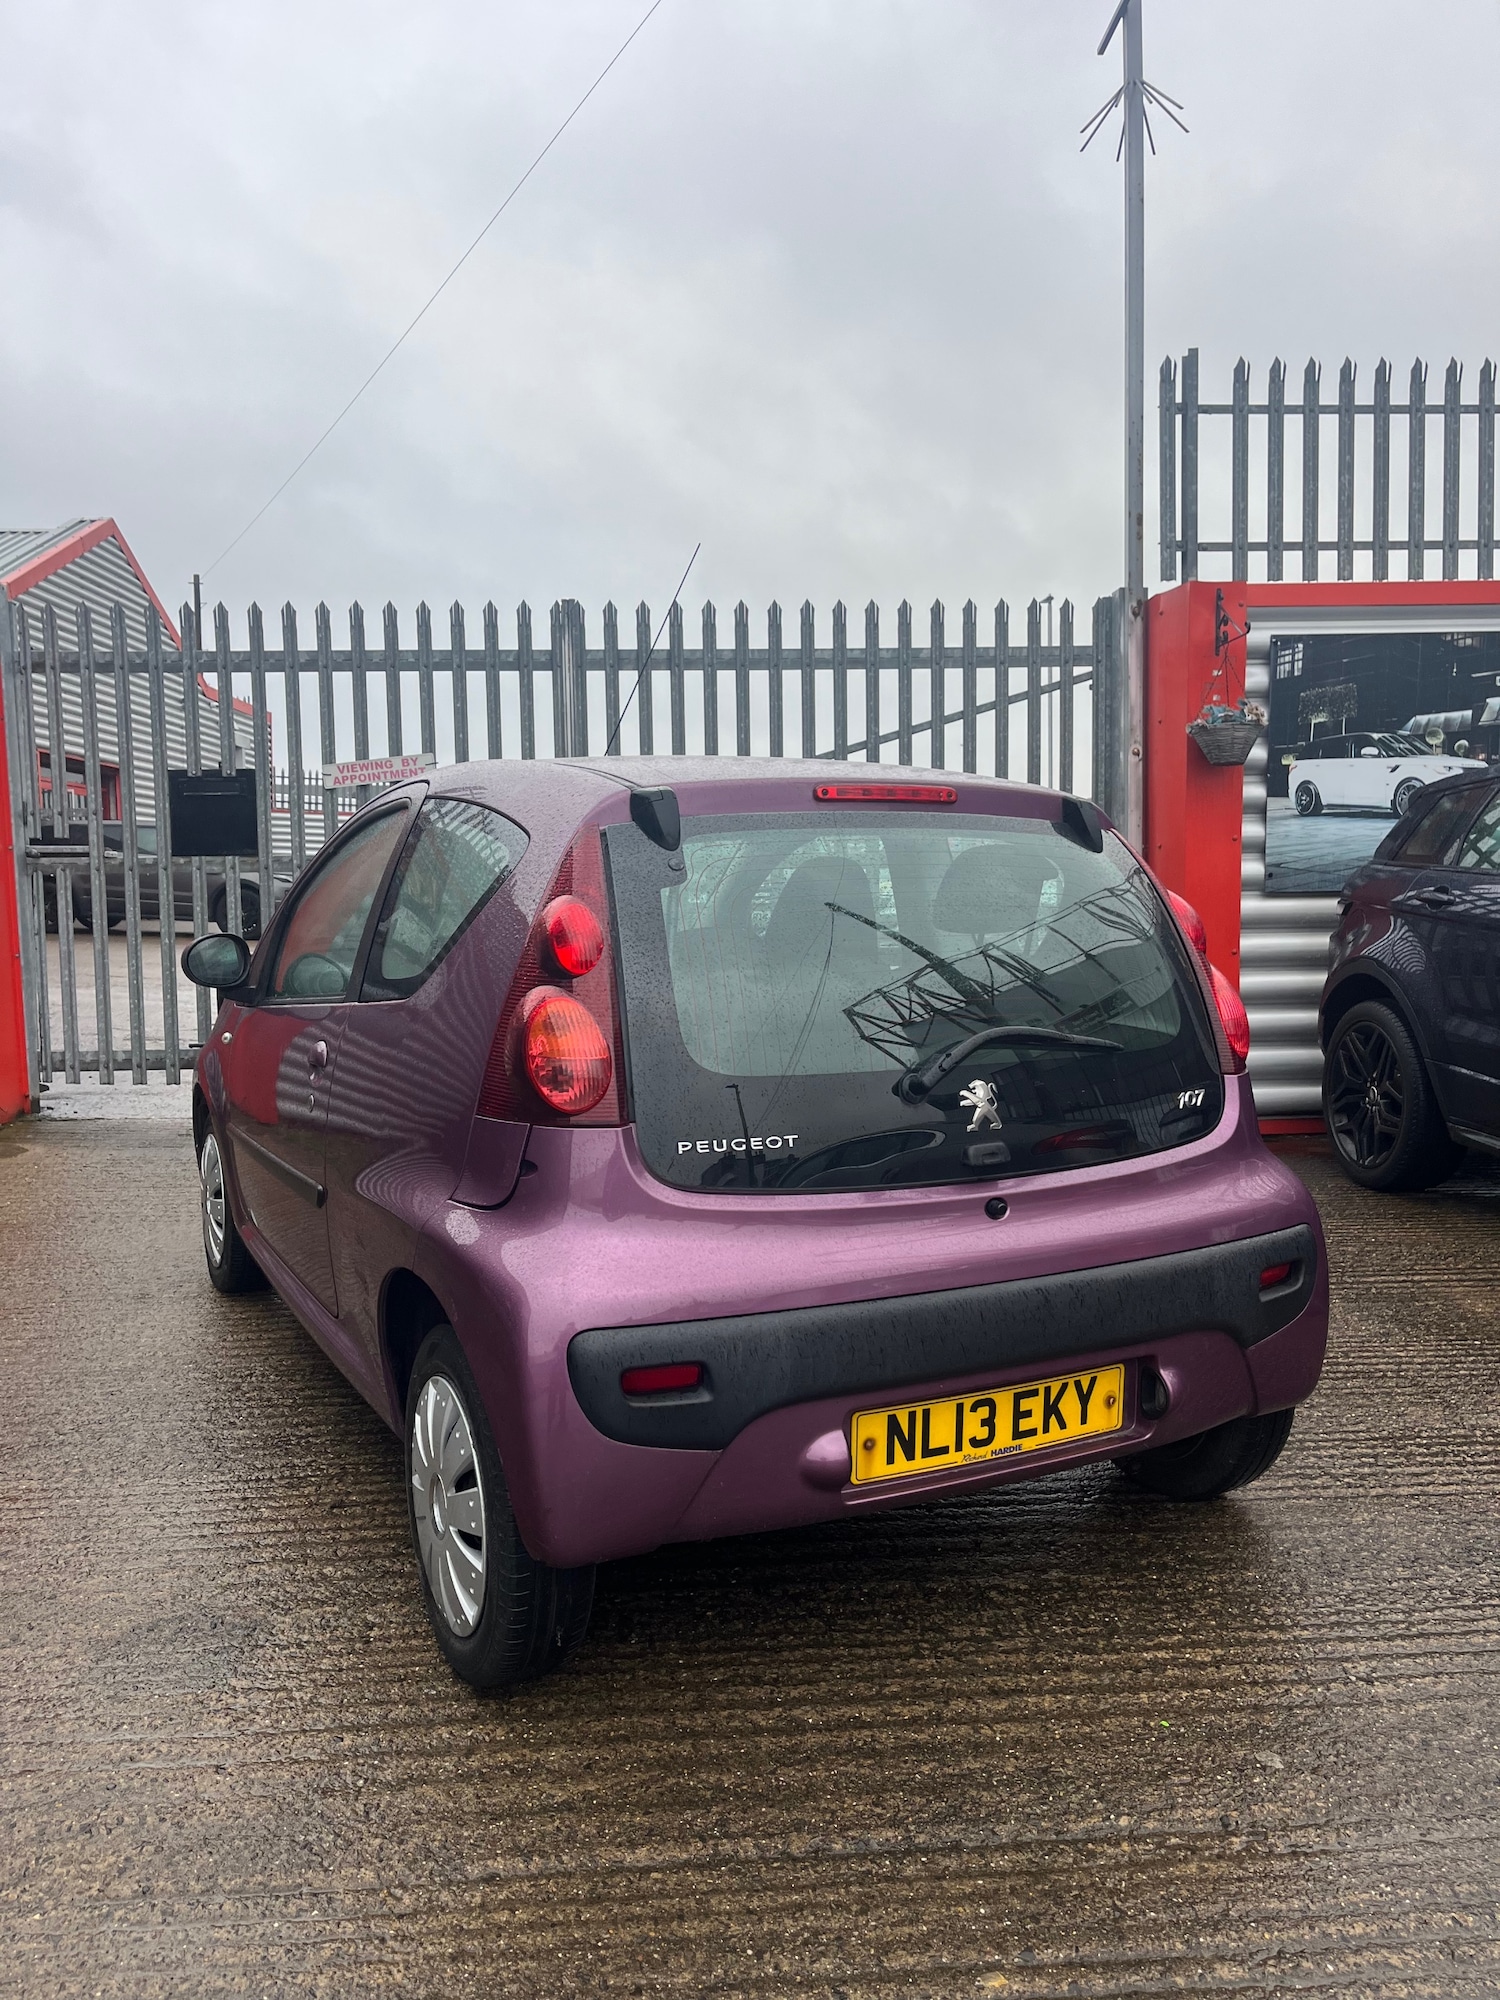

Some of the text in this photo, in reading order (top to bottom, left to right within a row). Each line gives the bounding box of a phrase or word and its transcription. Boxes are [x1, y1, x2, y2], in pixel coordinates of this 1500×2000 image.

[337, 757, 419, 774] VIEWING BY
[333, 767, 426, 786] APPOINTMENT
[1177, 1089, 1206, 1109] 107
[677, 1135, 799, 1155] PEUGEOT
[886, 1376, 1098, 1465] NL13 EKY
[990, 1443, 1023, 1457] HARDIE
